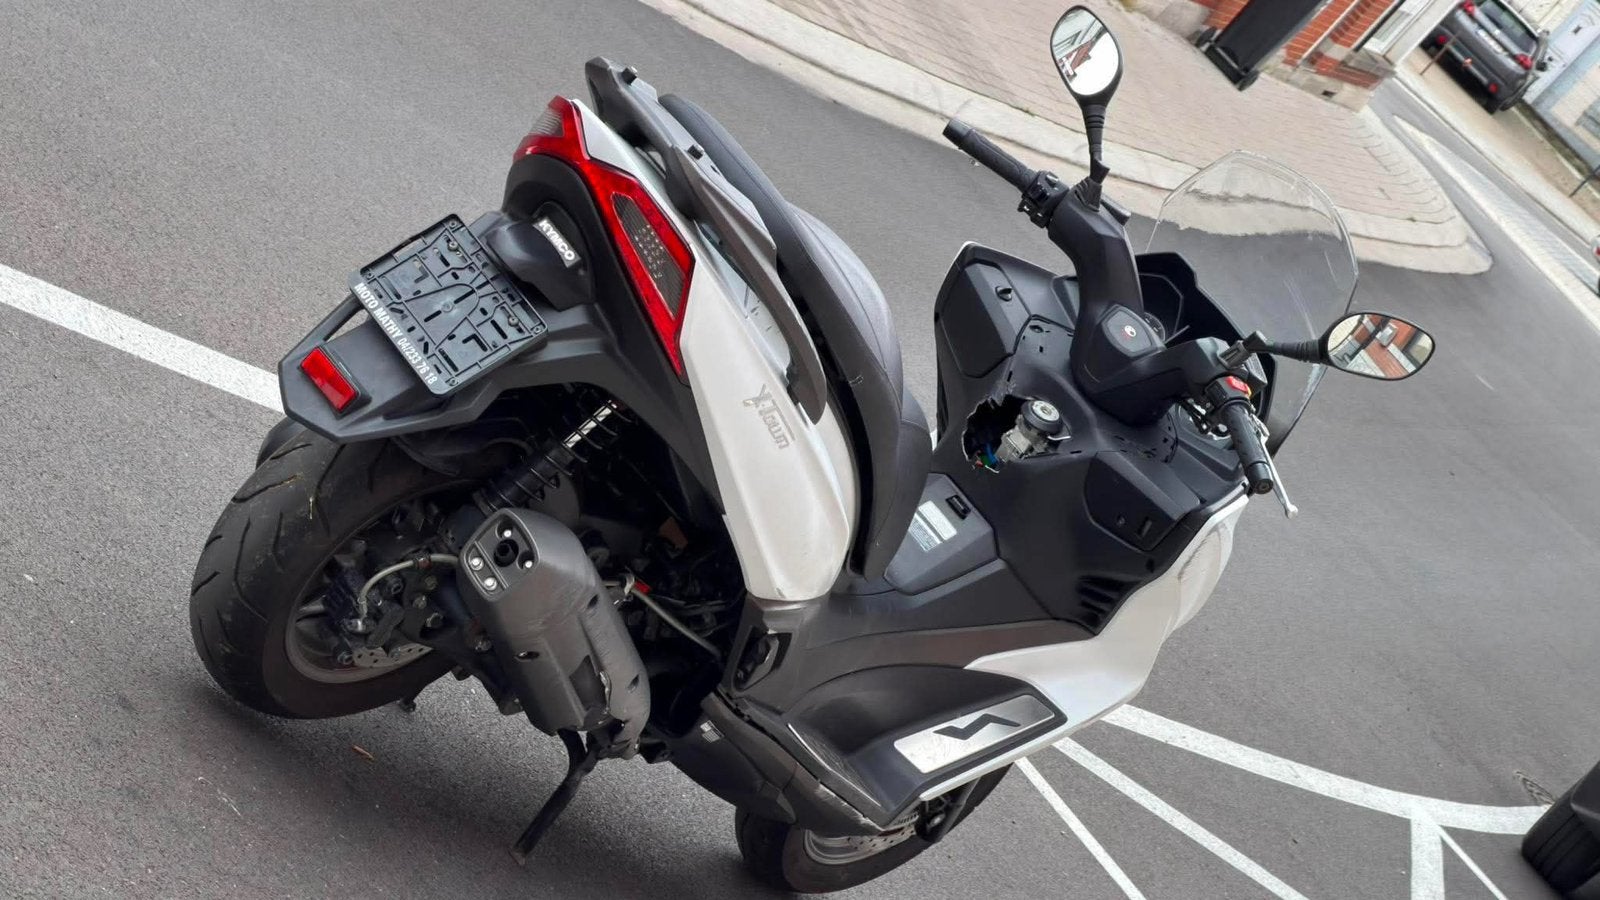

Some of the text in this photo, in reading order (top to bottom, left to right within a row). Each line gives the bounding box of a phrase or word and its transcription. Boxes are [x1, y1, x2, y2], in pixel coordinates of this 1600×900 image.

[539, 219, 576, 261] KYMCO
[354, 282, 438, 385] MOTO MATHY 04/233 76 18
